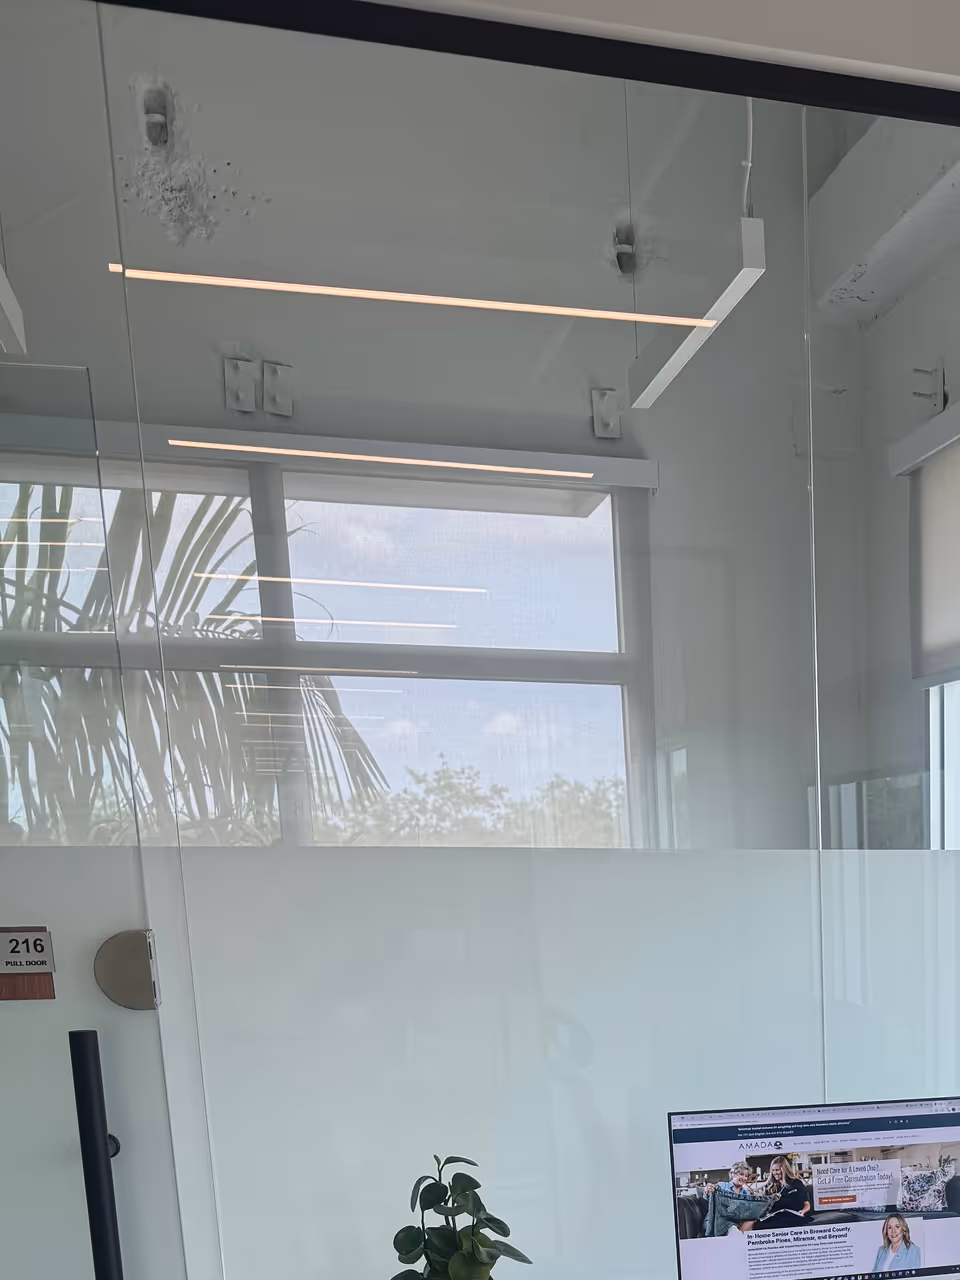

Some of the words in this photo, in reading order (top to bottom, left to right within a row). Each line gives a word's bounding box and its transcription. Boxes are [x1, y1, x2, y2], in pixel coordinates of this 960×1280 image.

[9, 938, 45, 954] 216
[738, 1141, 773, 1150] AMADA
[817, 1177, 827, 1185] Get
[844, 1174, 876, 1183] Consultation
[809, 1227, 832, 1235] Broward
